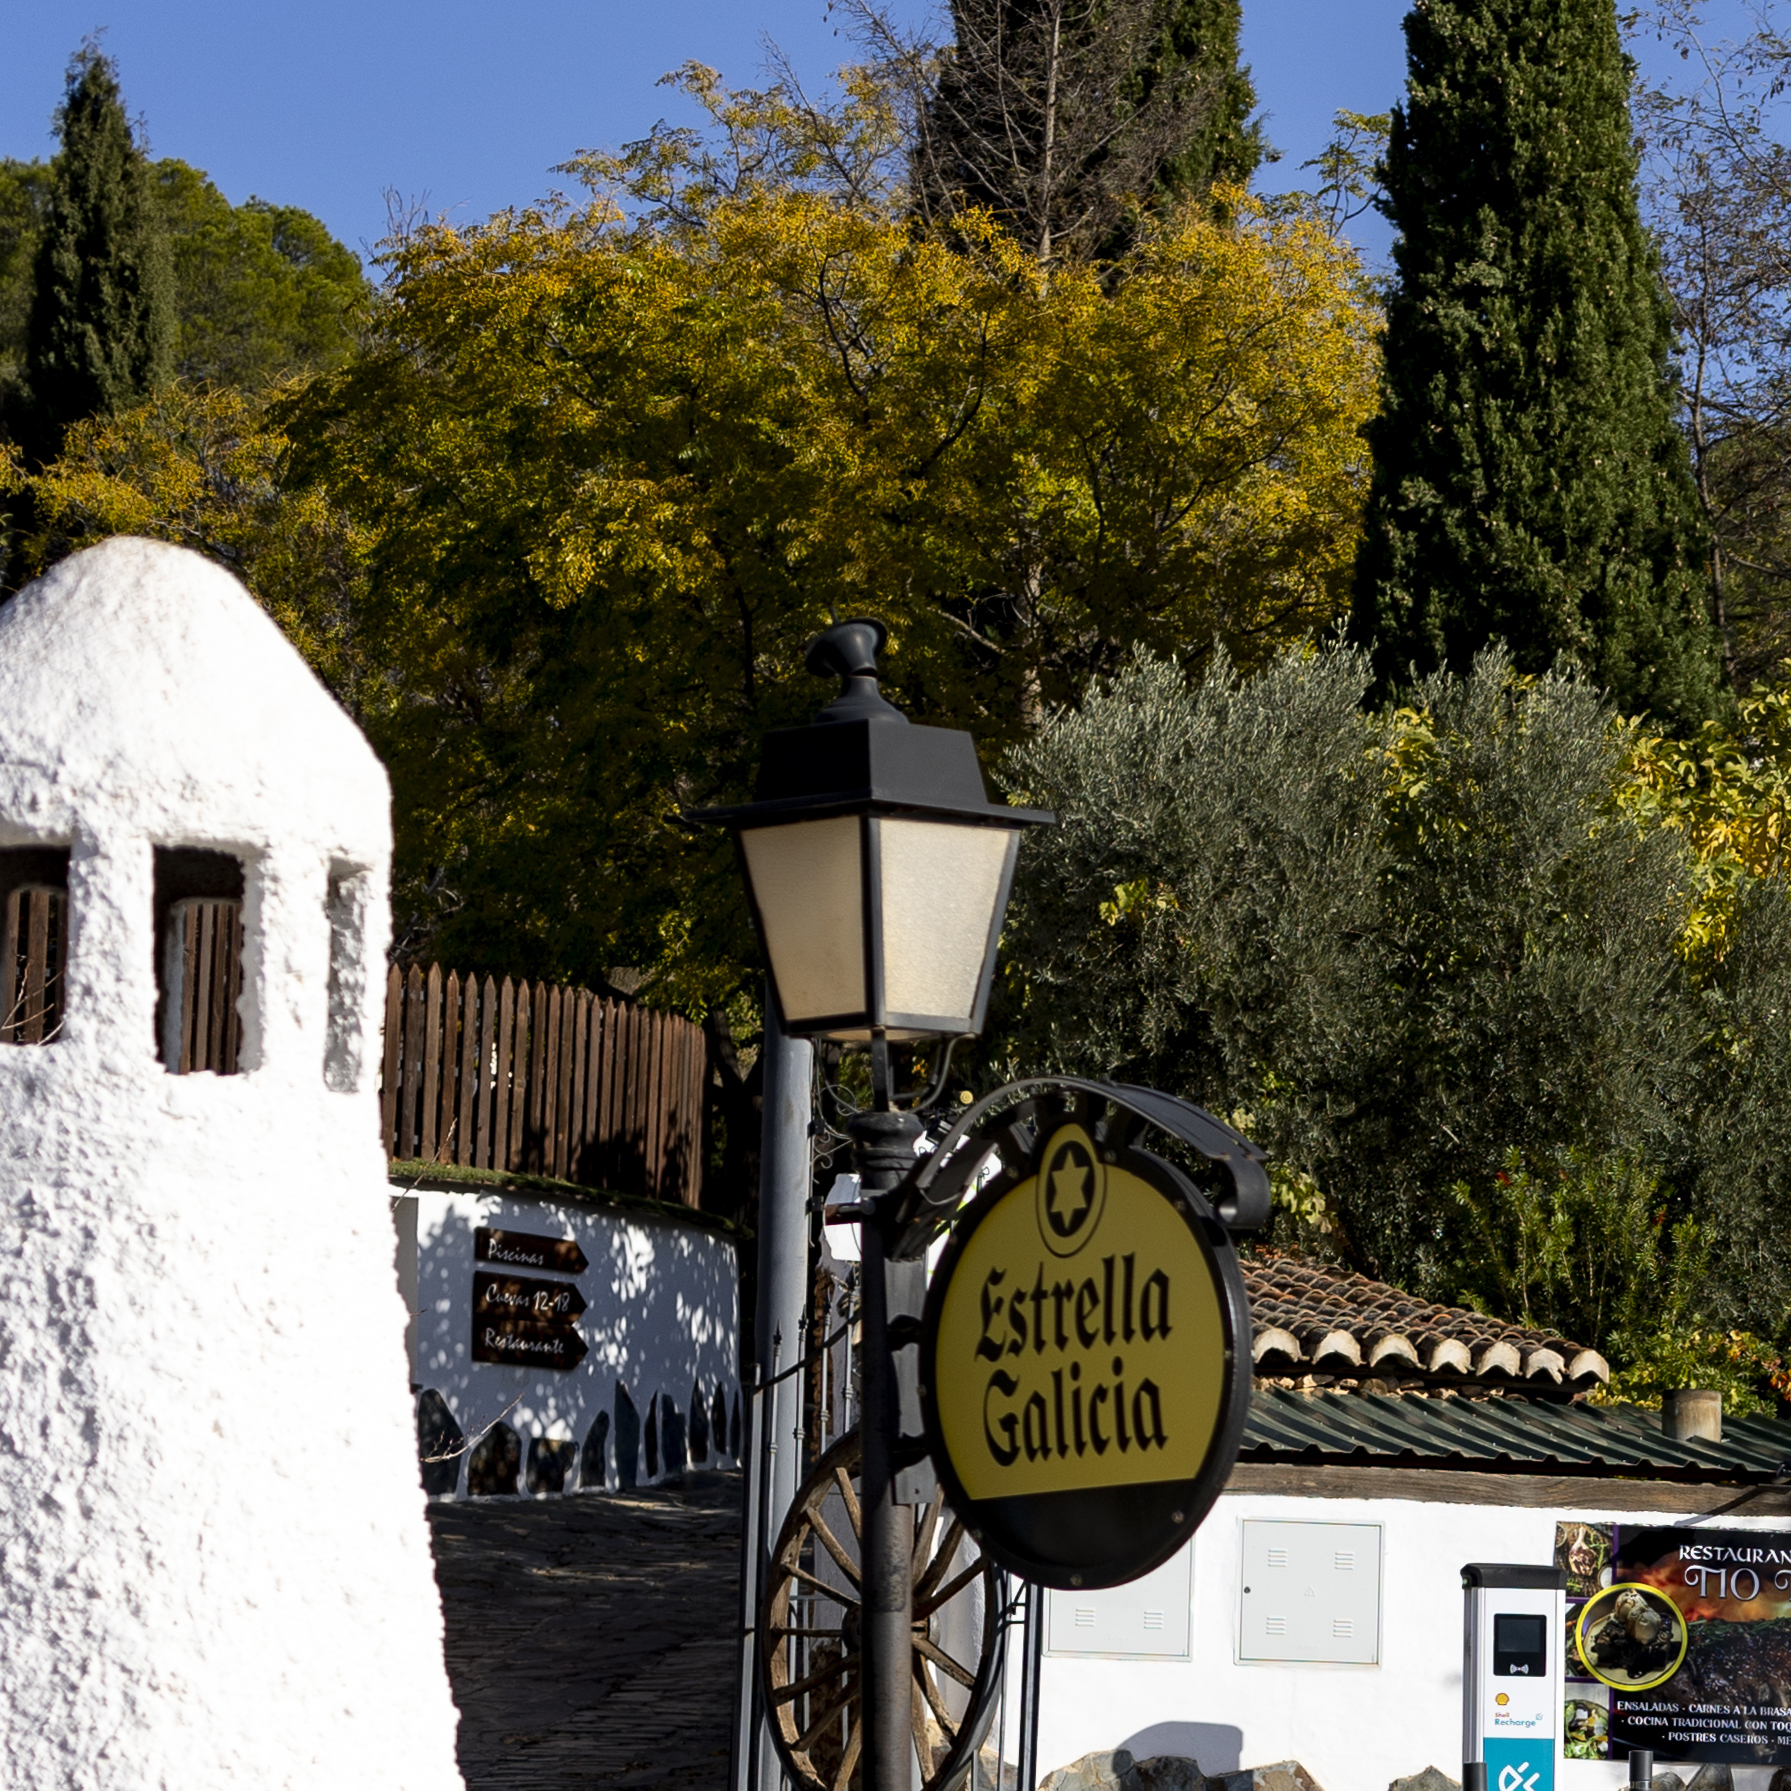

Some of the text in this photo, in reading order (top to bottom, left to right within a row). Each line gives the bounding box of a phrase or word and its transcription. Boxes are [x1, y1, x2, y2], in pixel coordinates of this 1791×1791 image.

[488, 1238, 544, 1265] Piscinas
[486, 1283, 570, 1312] Cuevas 12-18
[974, 1251, 1173, 1362] Estrella
[485, 1327, 564, 1354] Restaurante
[983, 1356, 1168, 1467] Galicia
[1617, 1700, 1679, 1712] ENSALADAS
[1688, 1703, 1731, 1714] CARNES
[1733, 1705, 1741, 1715] A
[1744, 1706, 1757, 1715] LA
[1494, 1718, 1536, 1728] Recharge
[1627, 1716, 1669, 1726] COCINA
[1672, 1717, 1741, 1729] TRADICIONAL
[1744, 1720, 1767, 1731] CON
[1668, 1731, 1717, 1743] POSTRES
[1720, 1733, 1768, 1745] CASEROS
